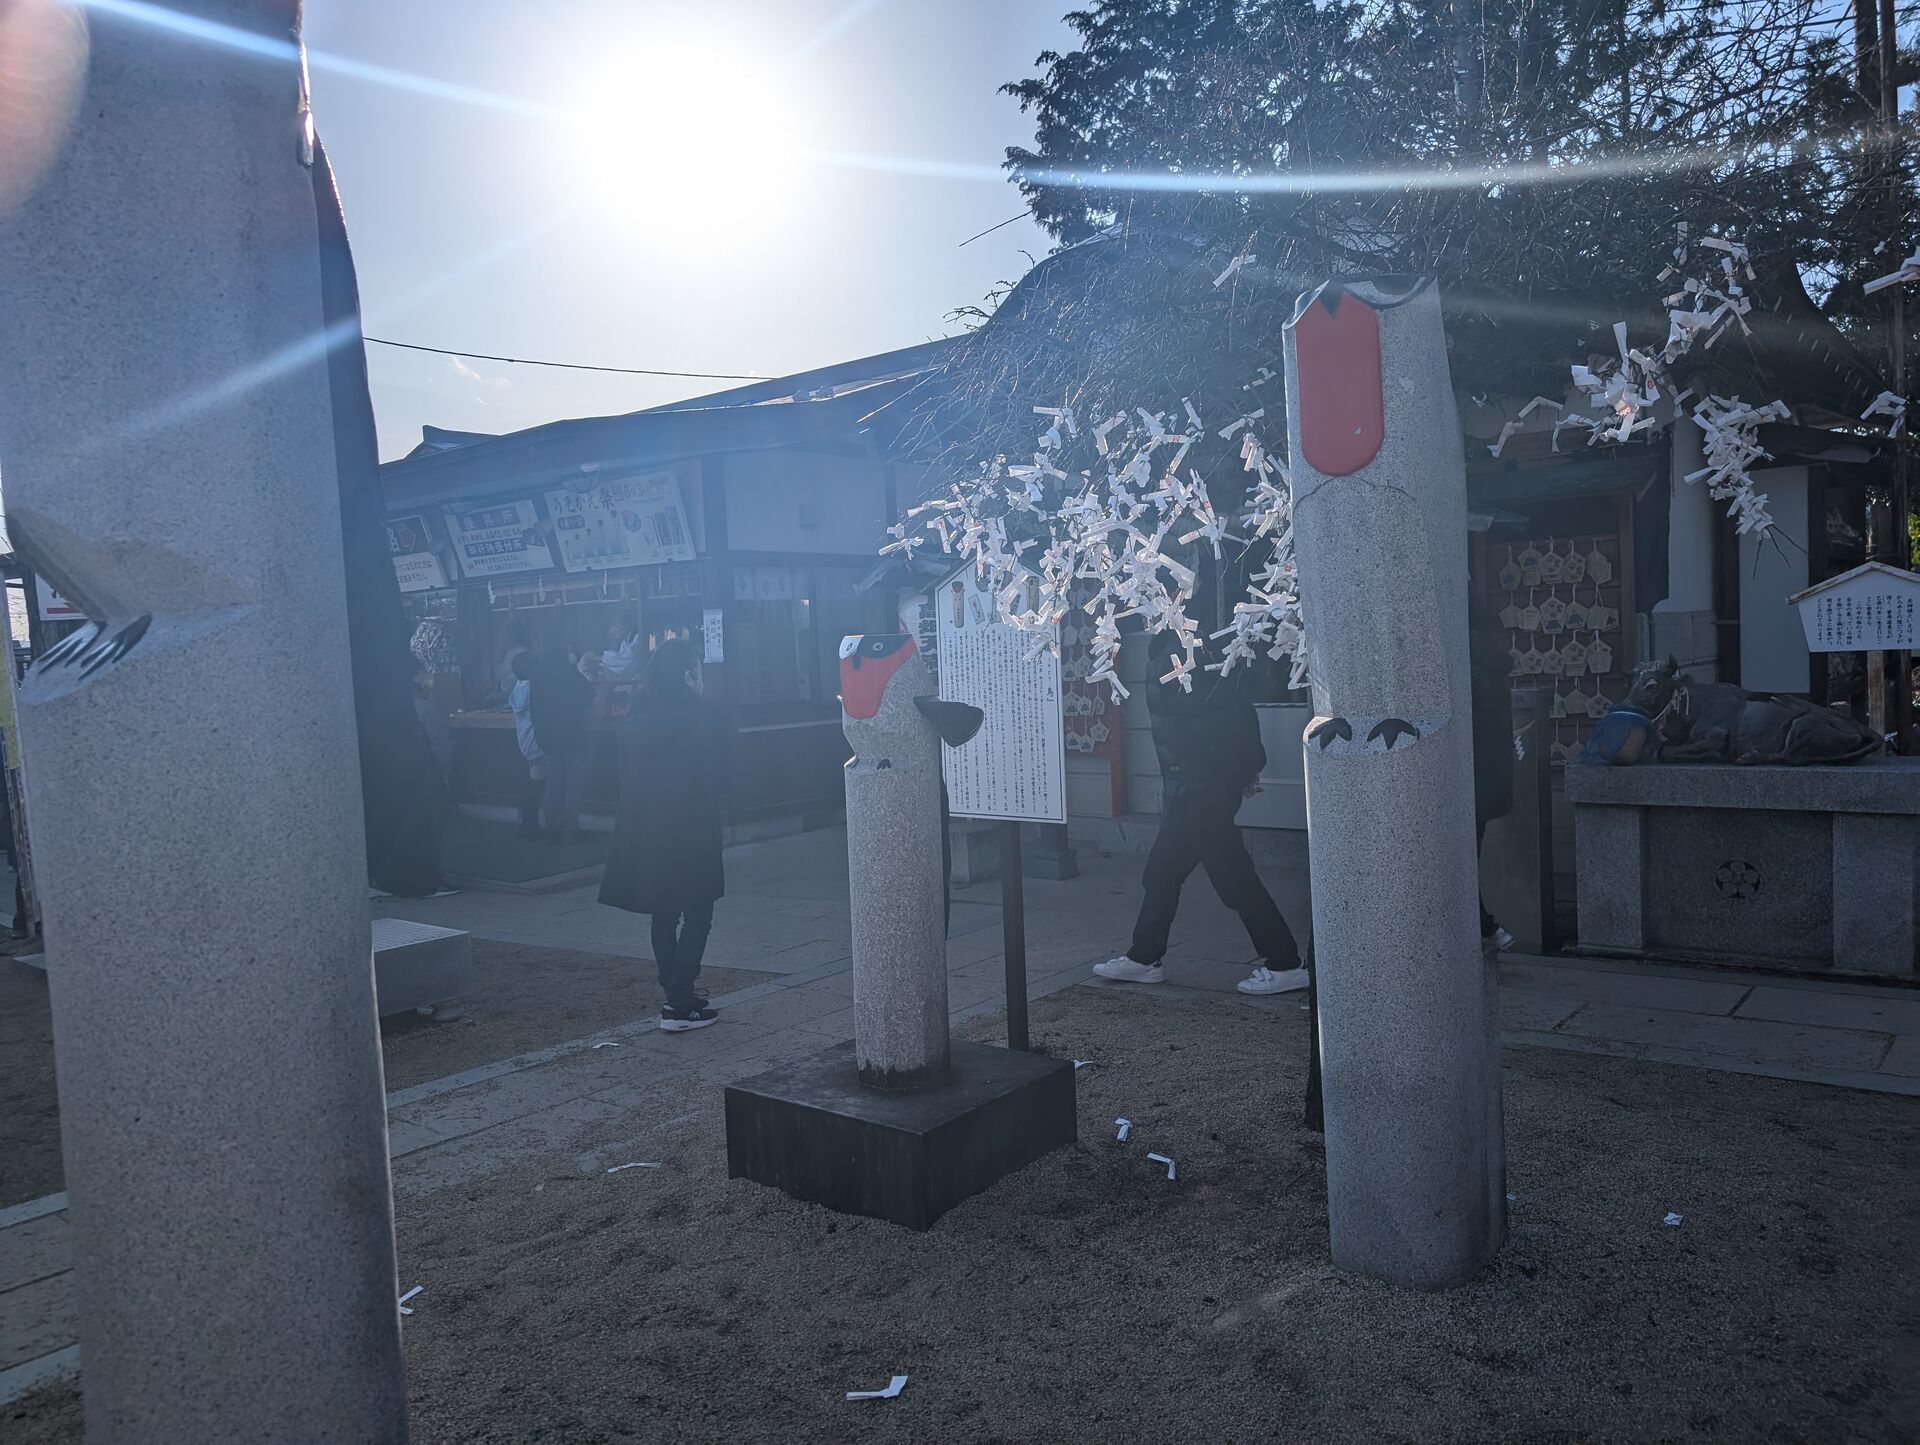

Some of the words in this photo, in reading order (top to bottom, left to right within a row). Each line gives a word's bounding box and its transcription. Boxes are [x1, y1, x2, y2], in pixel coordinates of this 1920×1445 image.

[553, 488, 615, 514] うそかえ祭
